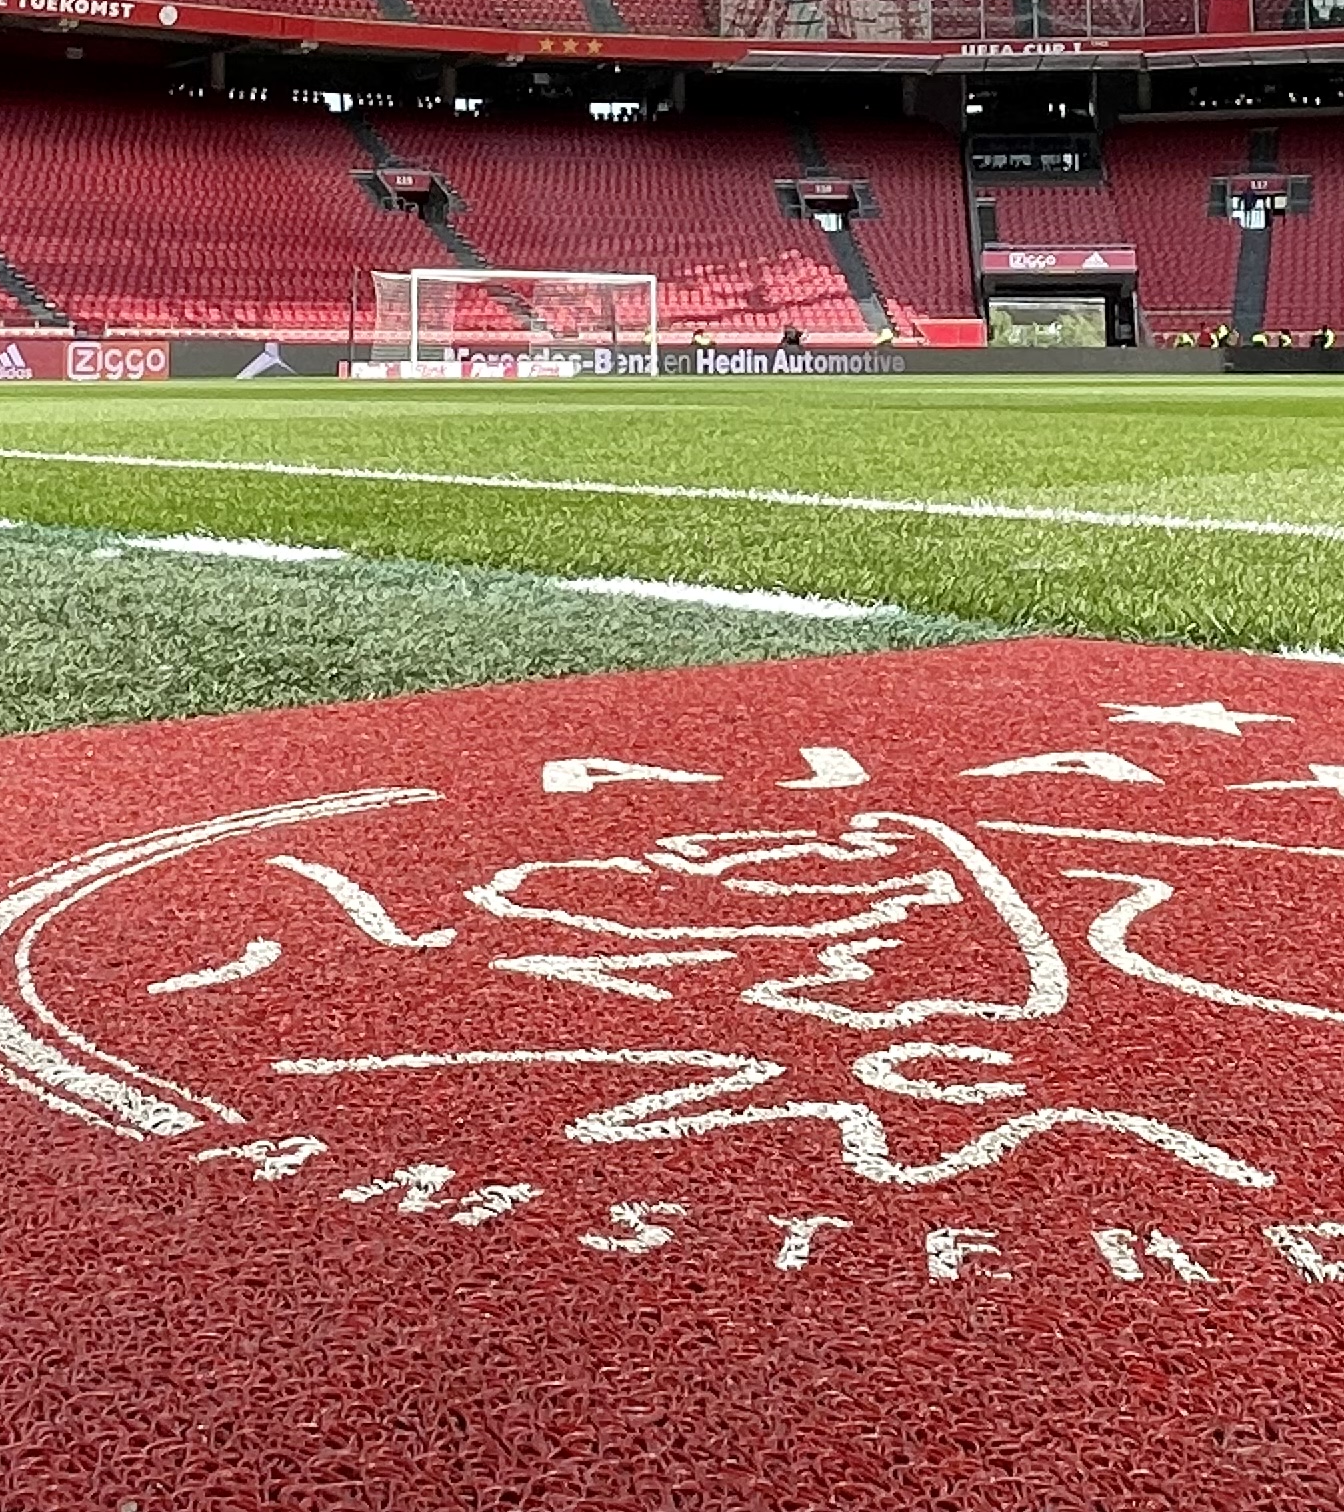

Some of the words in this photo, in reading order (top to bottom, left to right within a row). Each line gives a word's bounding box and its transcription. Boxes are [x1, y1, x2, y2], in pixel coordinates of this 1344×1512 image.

[961, 44, 1015, 55] UEFA
[1022, 42, 1066, 55] CUP
[664, 353, 691, 374] en
[696, 348, 768, 374] Hedin
[773, 348, 905, 374] Automotive
